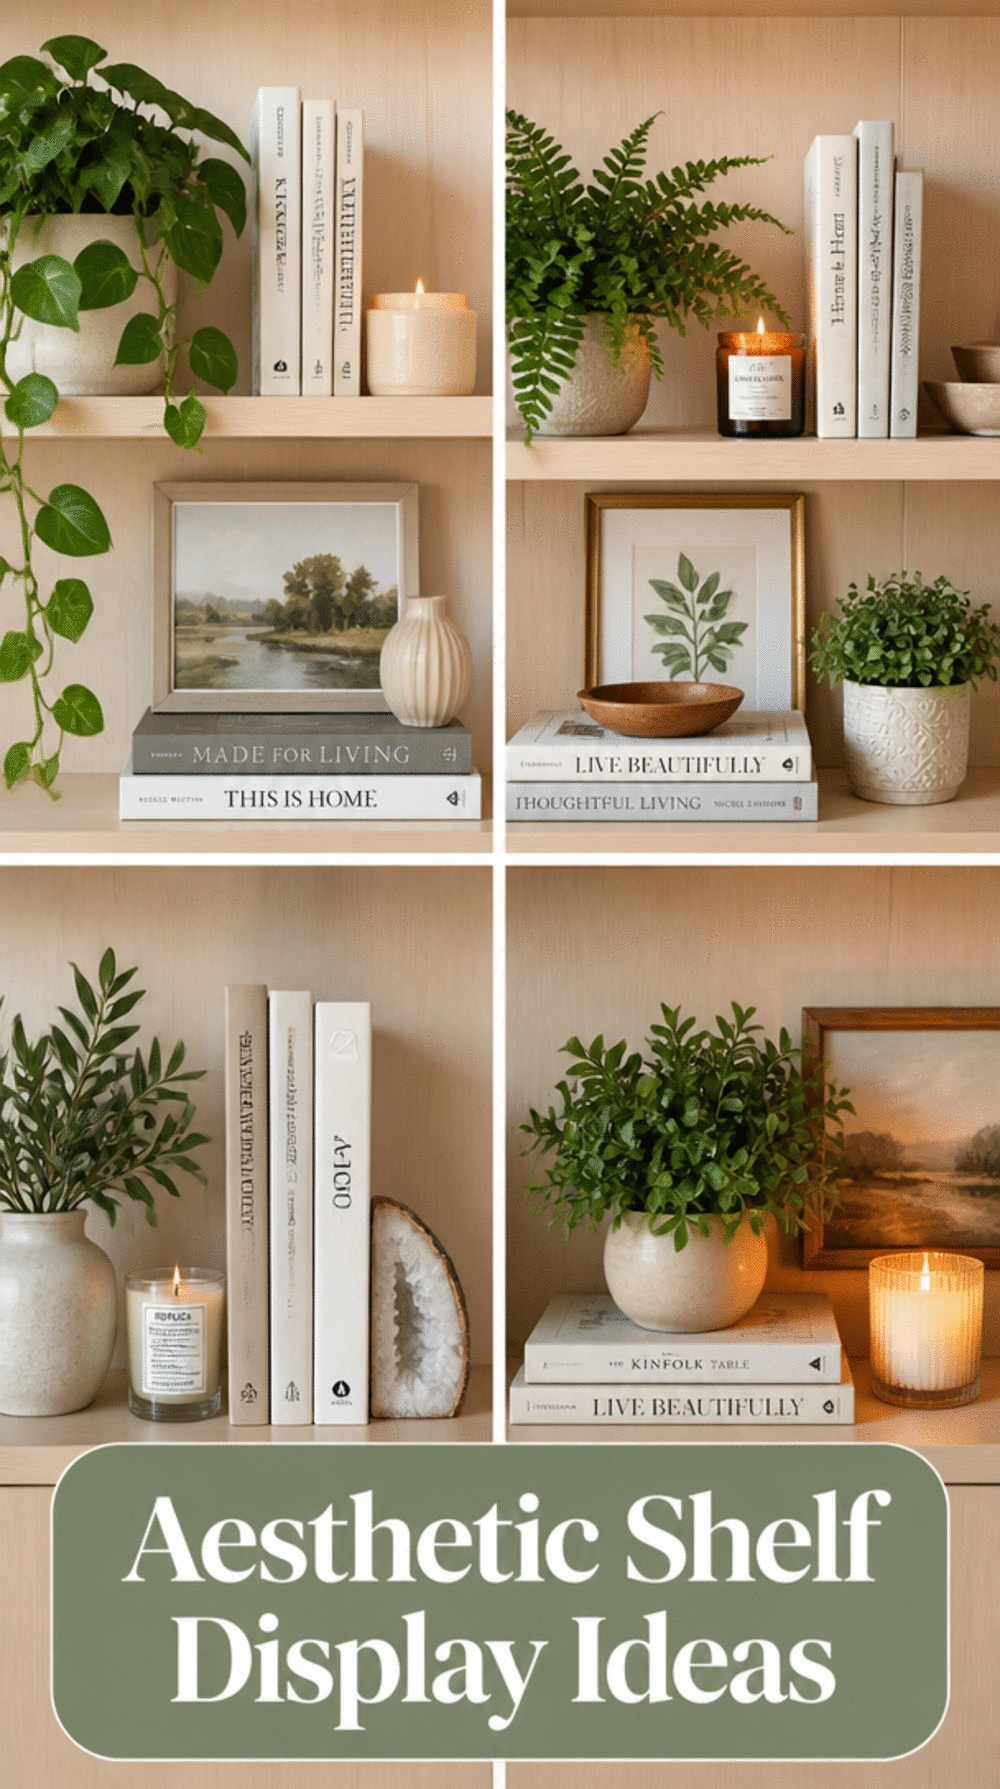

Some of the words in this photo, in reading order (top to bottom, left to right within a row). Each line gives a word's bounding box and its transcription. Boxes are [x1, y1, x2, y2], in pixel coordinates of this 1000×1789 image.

[193, 746, 265, 764] MADE
[273, 747, 312, 763] FOR
[320, 745, 410, 764] LIVING
[575, 756, 623, 774] LIVE
[628, 756, 766, 774] BEAUTIFULLY
[224, 790, 279, 808] THIS
[284, 790, 303, 808] IS
[308, 790, 378, 808] HOME
[640, 796, 702, 811] LIVING
[631, 1358, 704, 1371] KINFOLK
[710, 1358, 750, 1370] TABLE
[593, 1398, 645, 1417] LIVE
[652, 1398, 804, 1417] BEAUTIFULLY
